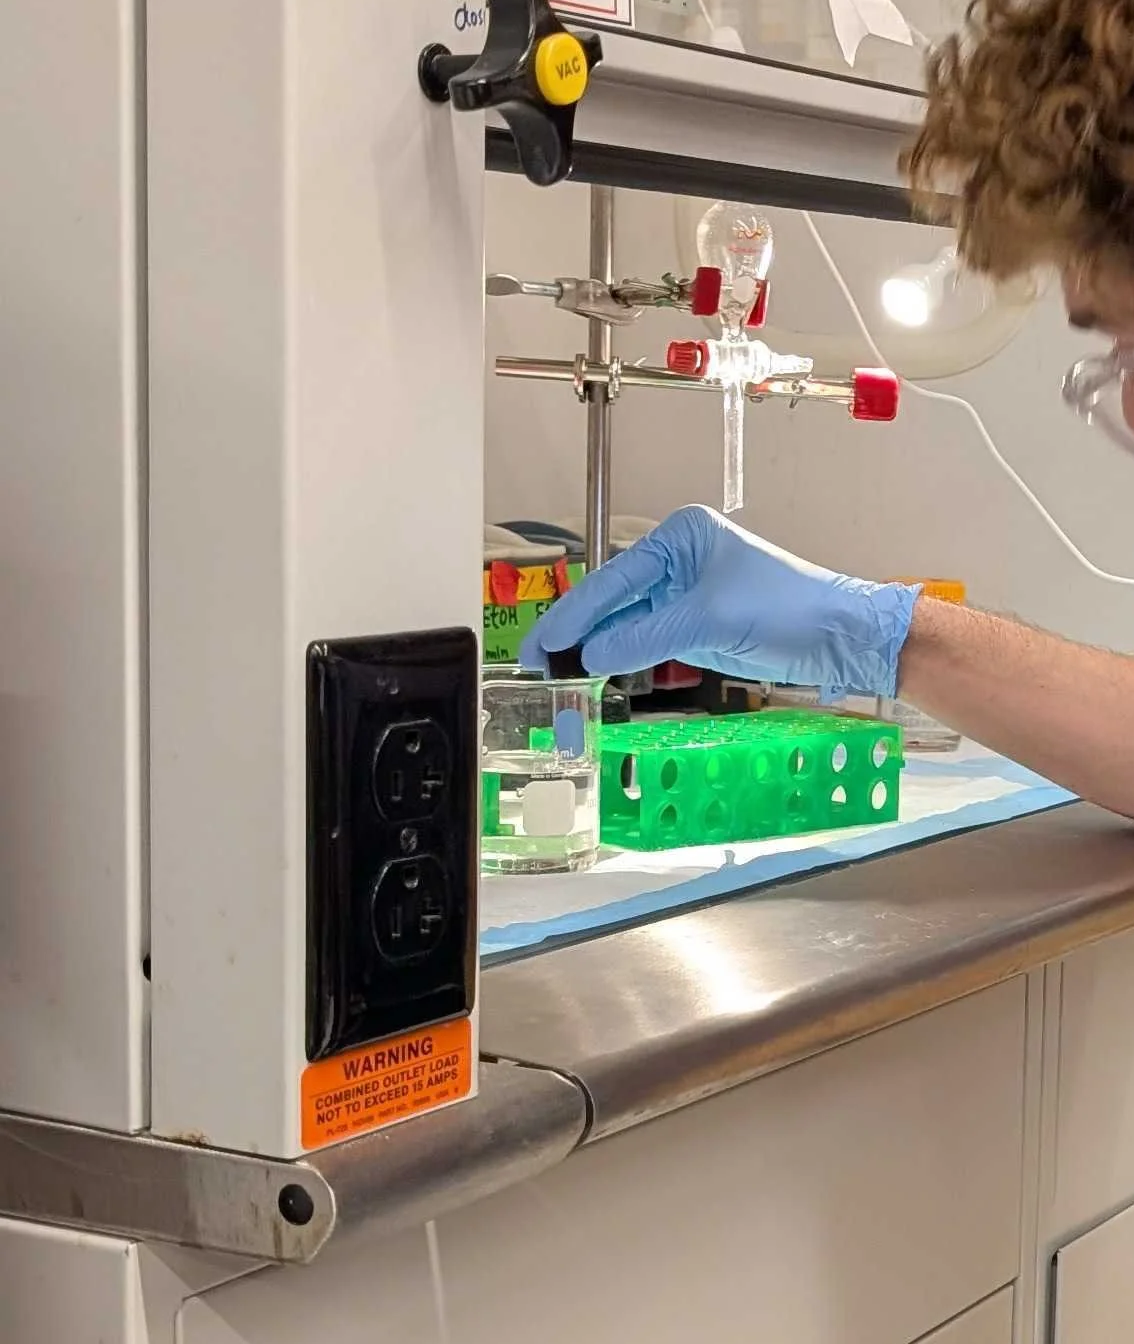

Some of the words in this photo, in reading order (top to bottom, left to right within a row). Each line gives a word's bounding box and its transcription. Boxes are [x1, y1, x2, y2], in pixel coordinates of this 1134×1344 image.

[556, 57, 581, 80] VAC
[315, 1080, 380, 1110] COMBINED
[383, 1064, 426, 1089] OUTLET
[430, 1054, 459, 1073] LOAD
[343, 1037, 433, 1081] WARNING
[317, 1108, 341, 1125] NOT
[346, 1101, 361, 1115] TO
[364, 1084, 409, 1109] EXCEED
[412, 1079, 424, 1094] 15
[426, 1068, 458, 1088] AMPS
